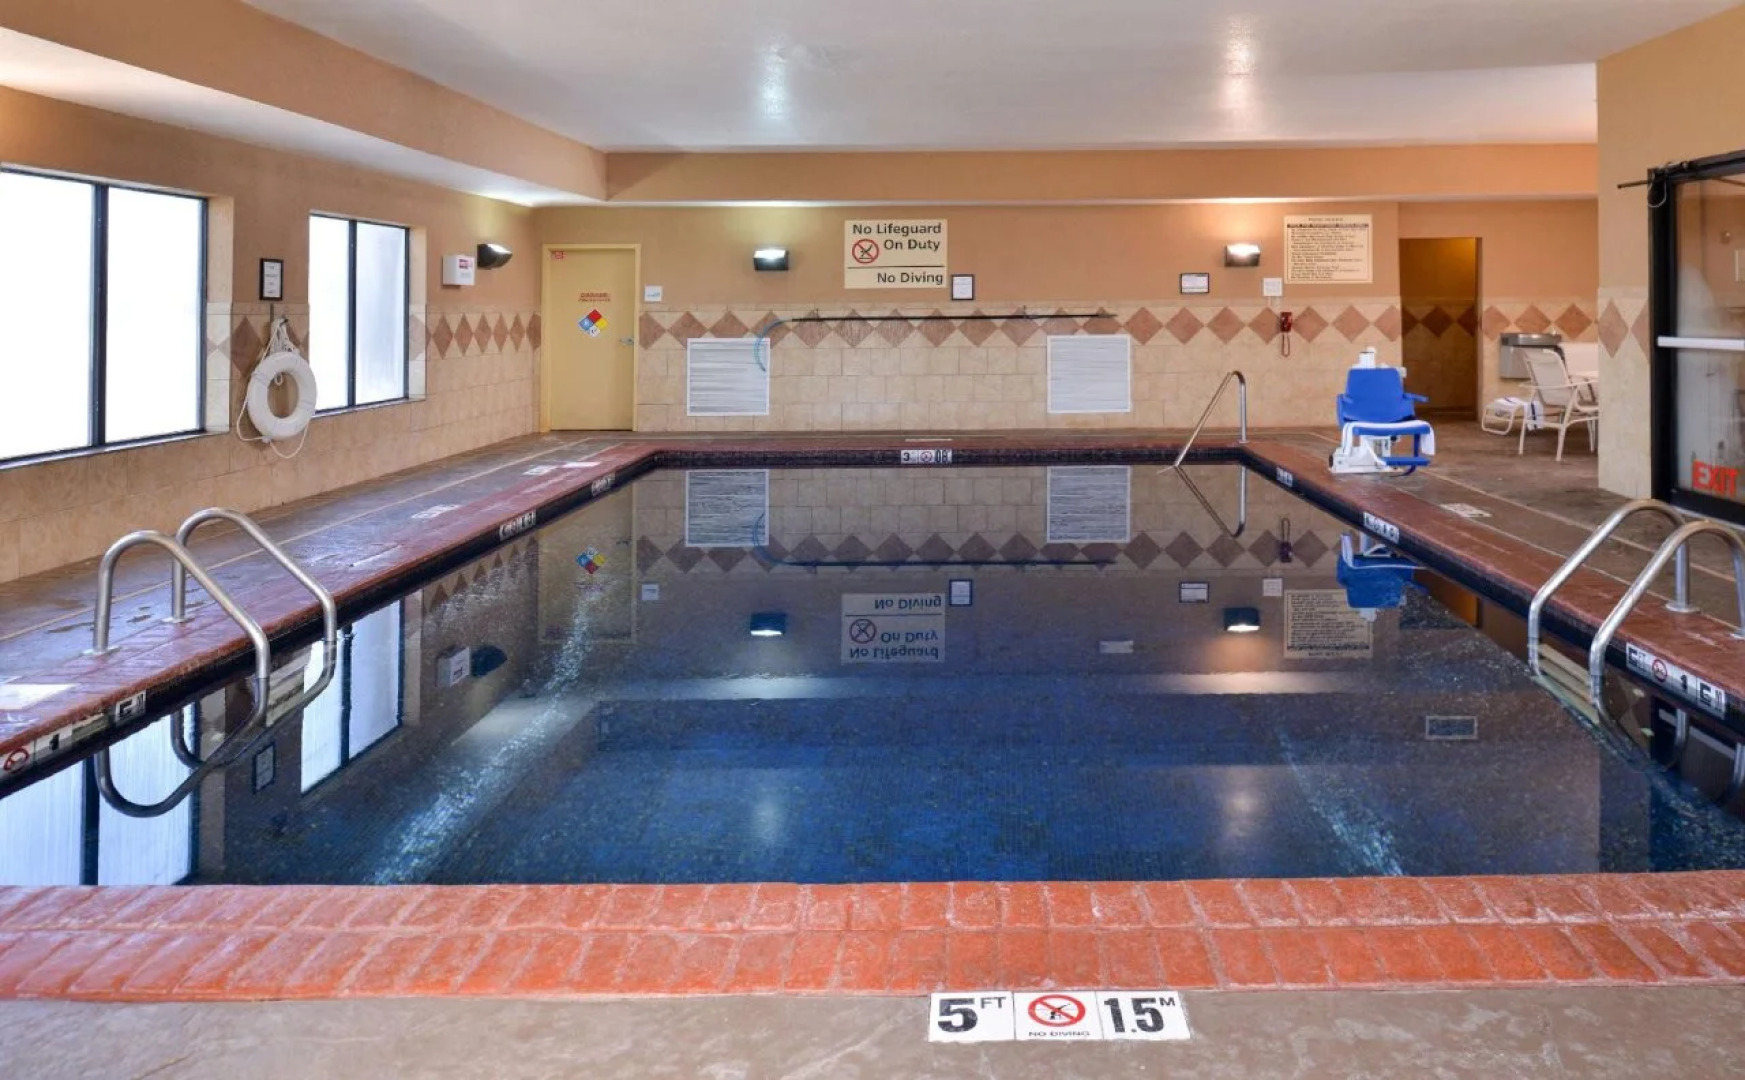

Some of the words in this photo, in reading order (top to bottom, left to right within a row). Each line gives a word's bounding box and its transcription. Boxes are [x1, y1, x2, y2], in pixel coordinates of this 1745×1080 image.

[852, 224, 872, 235] No
[877, 223, 942, 236] Lifeguard
[883, 239, 903, 250] On
[908, 239, 940, 252] Duty
[877, 272, 896, 283] No
[900, 272, 943, 285] Diving
[1692, 460, 1738, 499] EXIT
[938, 997, 978, 1033] 5
[980, 996, 1007, 1009] FT
[1104, 997, 1164, 1034] 1.5
[1160, 997, 1176, 1006] M
